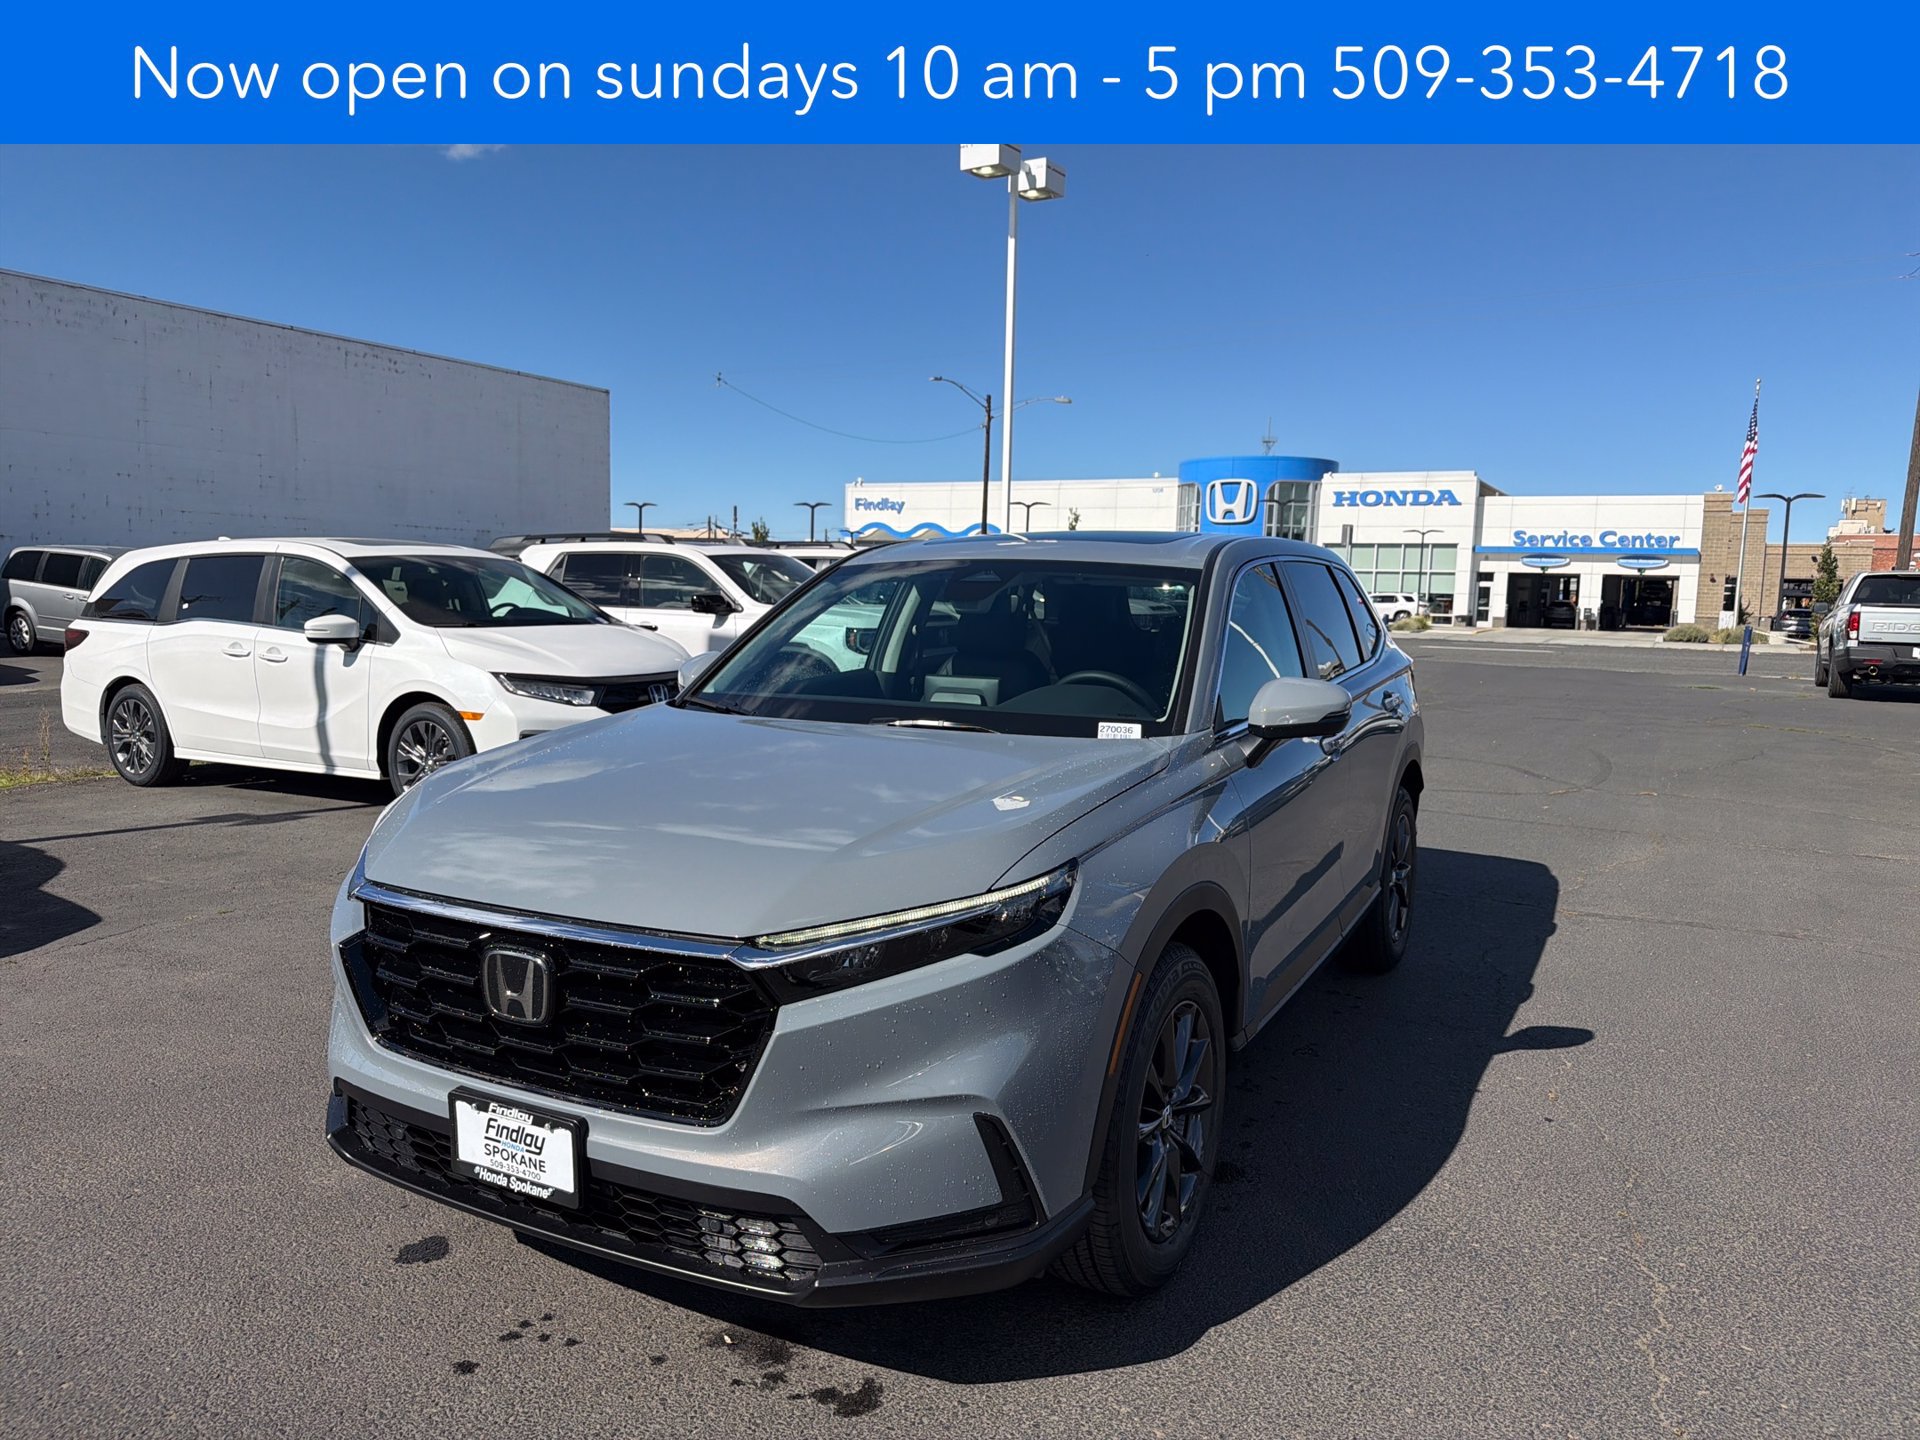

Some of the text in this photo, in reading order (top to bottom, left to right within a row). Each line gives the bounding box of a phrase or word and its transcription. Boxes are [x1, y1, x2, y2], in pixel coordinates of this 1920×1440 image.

[854, 497, 906, 515] Findlay
[1332, 489, 1463, 507] HONDA
[1513, 529, 1681, 548] Service Center
[1100, 725, 1133, 734] 270036
[489, 1102, 534, 1125] Findlay
[484, 1117, 546, 1156] Findlay
[501, 1140, 526, 1153] HONDA
[484, 1143, 547, 1174] SPOKANE
[489, 1159, 542, 1181] 509-353-4700
[478, 1166, 549, 1199] Honda Spokane
